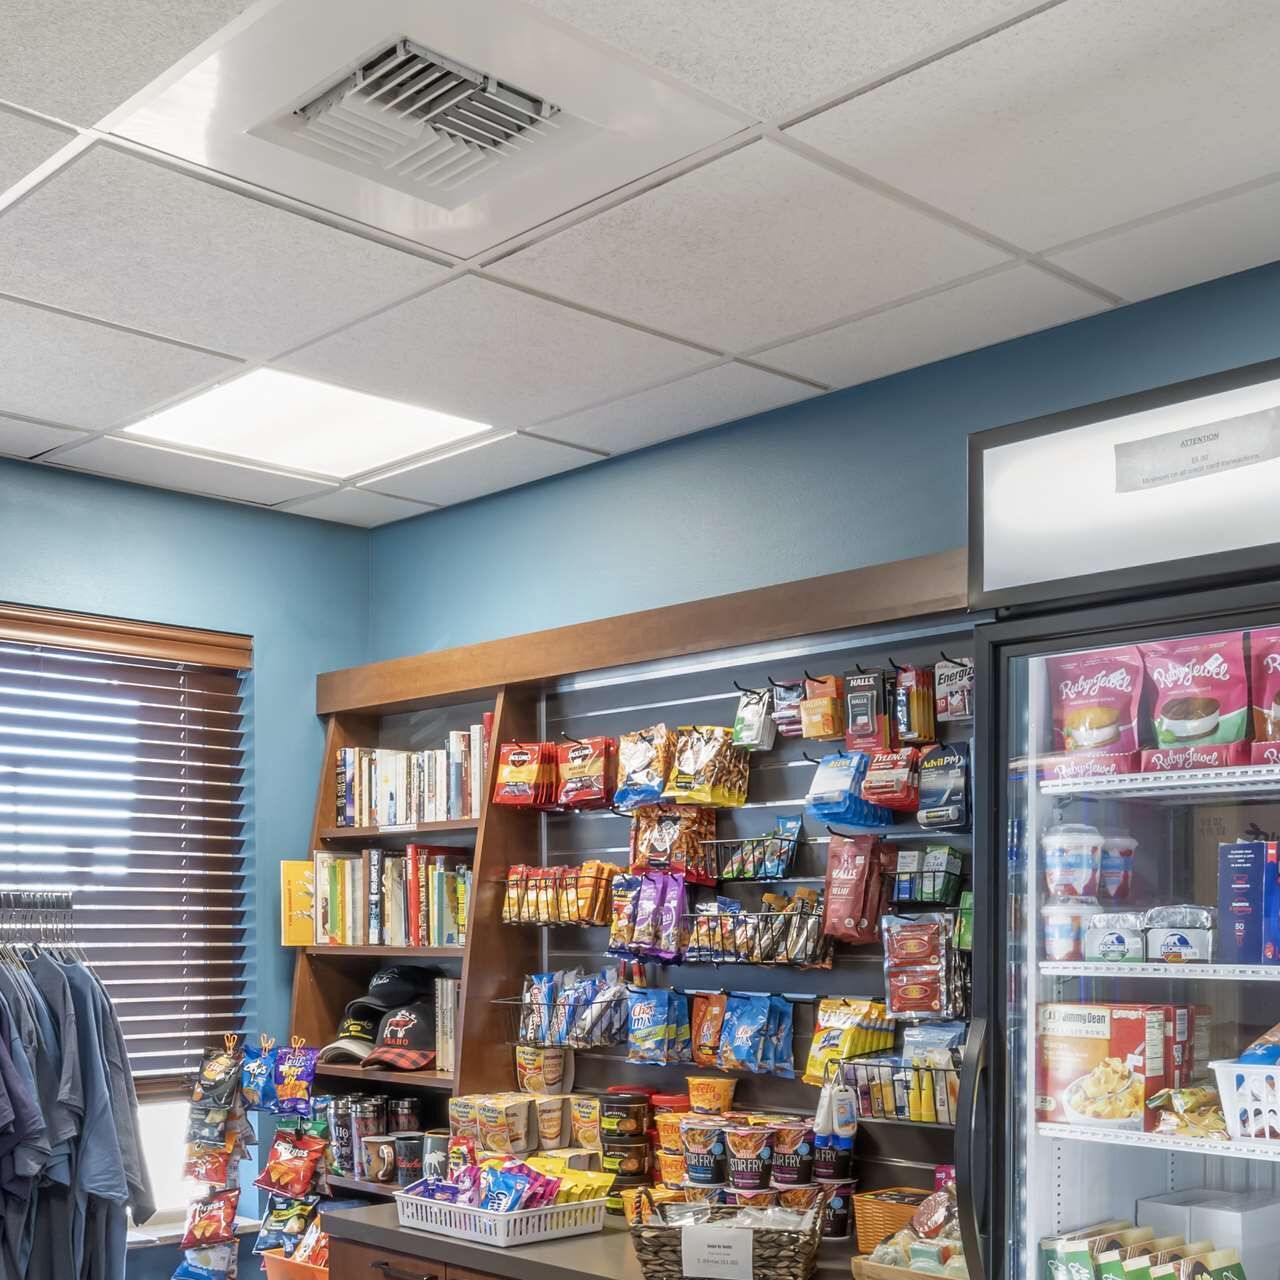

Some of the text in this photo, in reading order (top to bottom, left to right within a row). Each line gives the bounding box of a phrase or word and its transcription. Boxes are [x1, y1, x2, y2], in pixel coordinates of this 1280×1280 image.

[1180, 432, 1220, 448] ATTENTION
[937, 667, 975, 686] Energiz
[1154, 658, 1230, 689] Ruby Jewel
[850, 677, 875, 687] HALLS
[1060, 679, 1094, 699] Ruby
[922, 755, 960, 769] Advil PM
[1152, 747, 1219, 770] Ruby Jewel
[832, 869, 858, 879] HALLS
[1062, 1011, 1106, 1025] Jimmy Dean
[699, 1153, 715, 1168] FRY
[820, 1150, 837, 1163] FRY
[730, 1158, 764, 1172] STIR FRY
